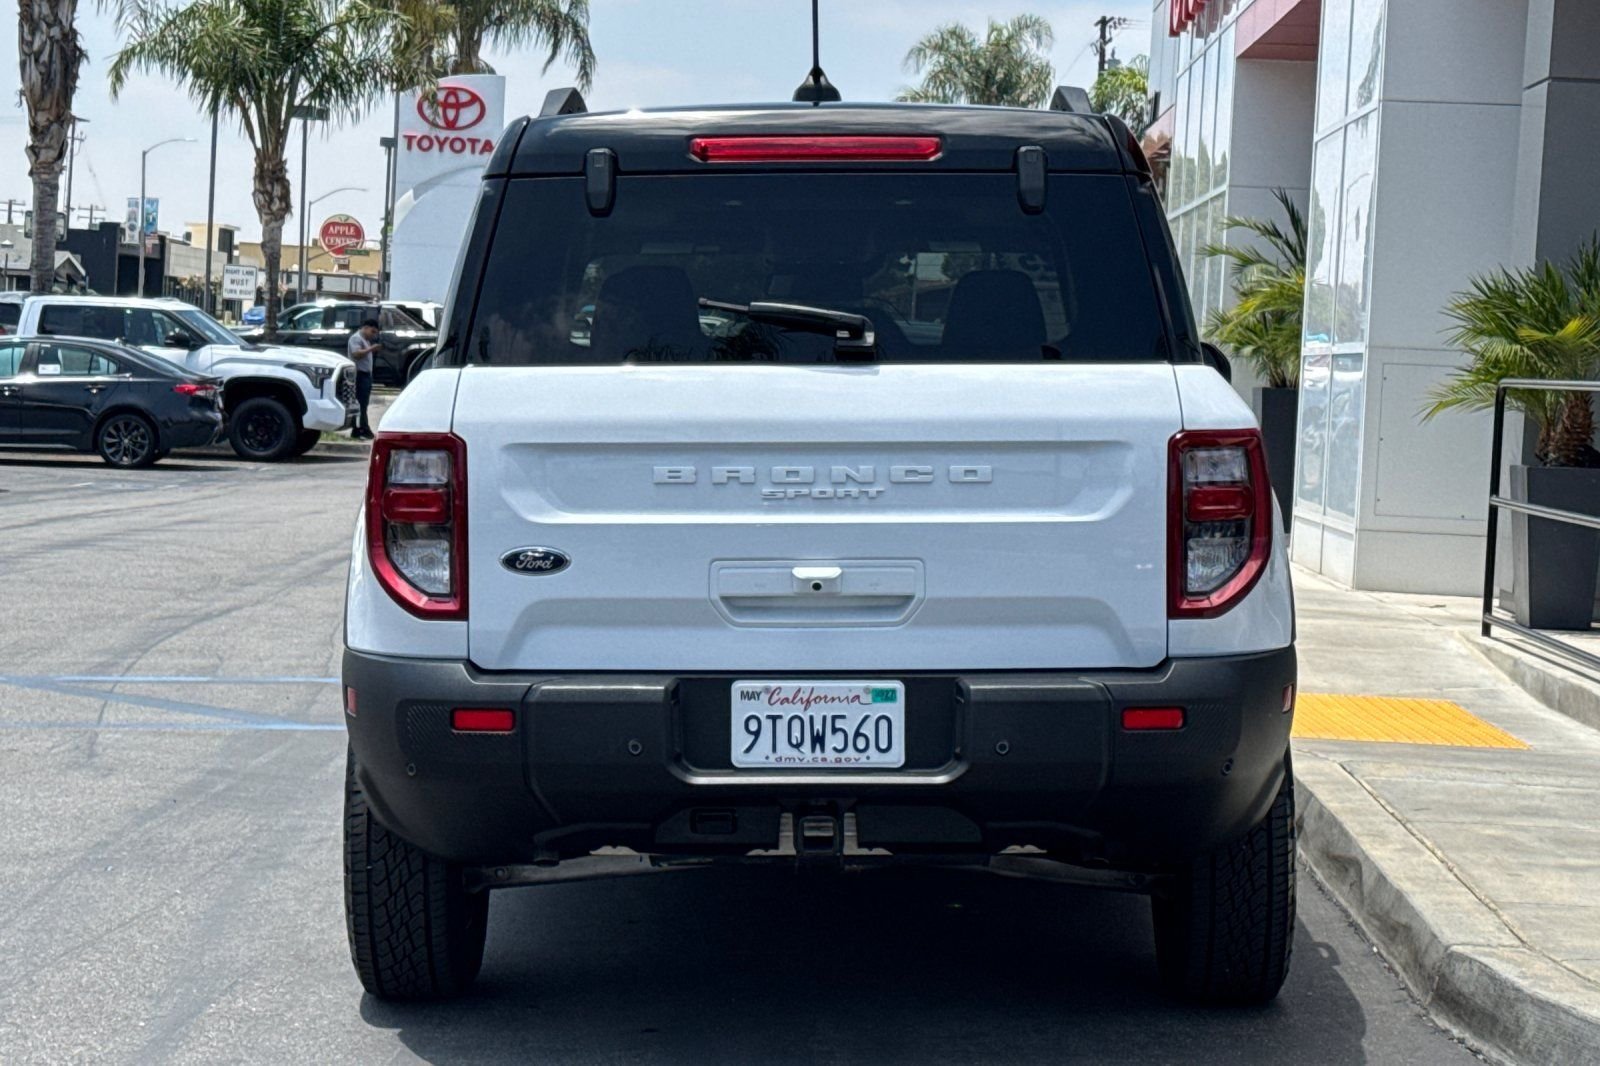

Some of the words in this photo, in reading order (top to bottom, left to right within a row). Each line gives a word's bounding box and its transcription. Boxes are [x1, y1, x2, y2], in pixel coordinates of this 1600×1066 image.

[403, 135, 495, 155] TOYOTA
[328, 225, 356, 236] APPLE
[230, 278, 249, 286] MUST
[653, 465, 993, 484] BRONCO
[761, 487, 885, 500] SPORT
[515, 551, 554, 569] Ford
[740, 690, 762, 701] MAY
[767, 686, 872, 712] California
[743, 714, 893, 754] 9TQW560
[775, 755, 862, 763] dmv.ca.gov
